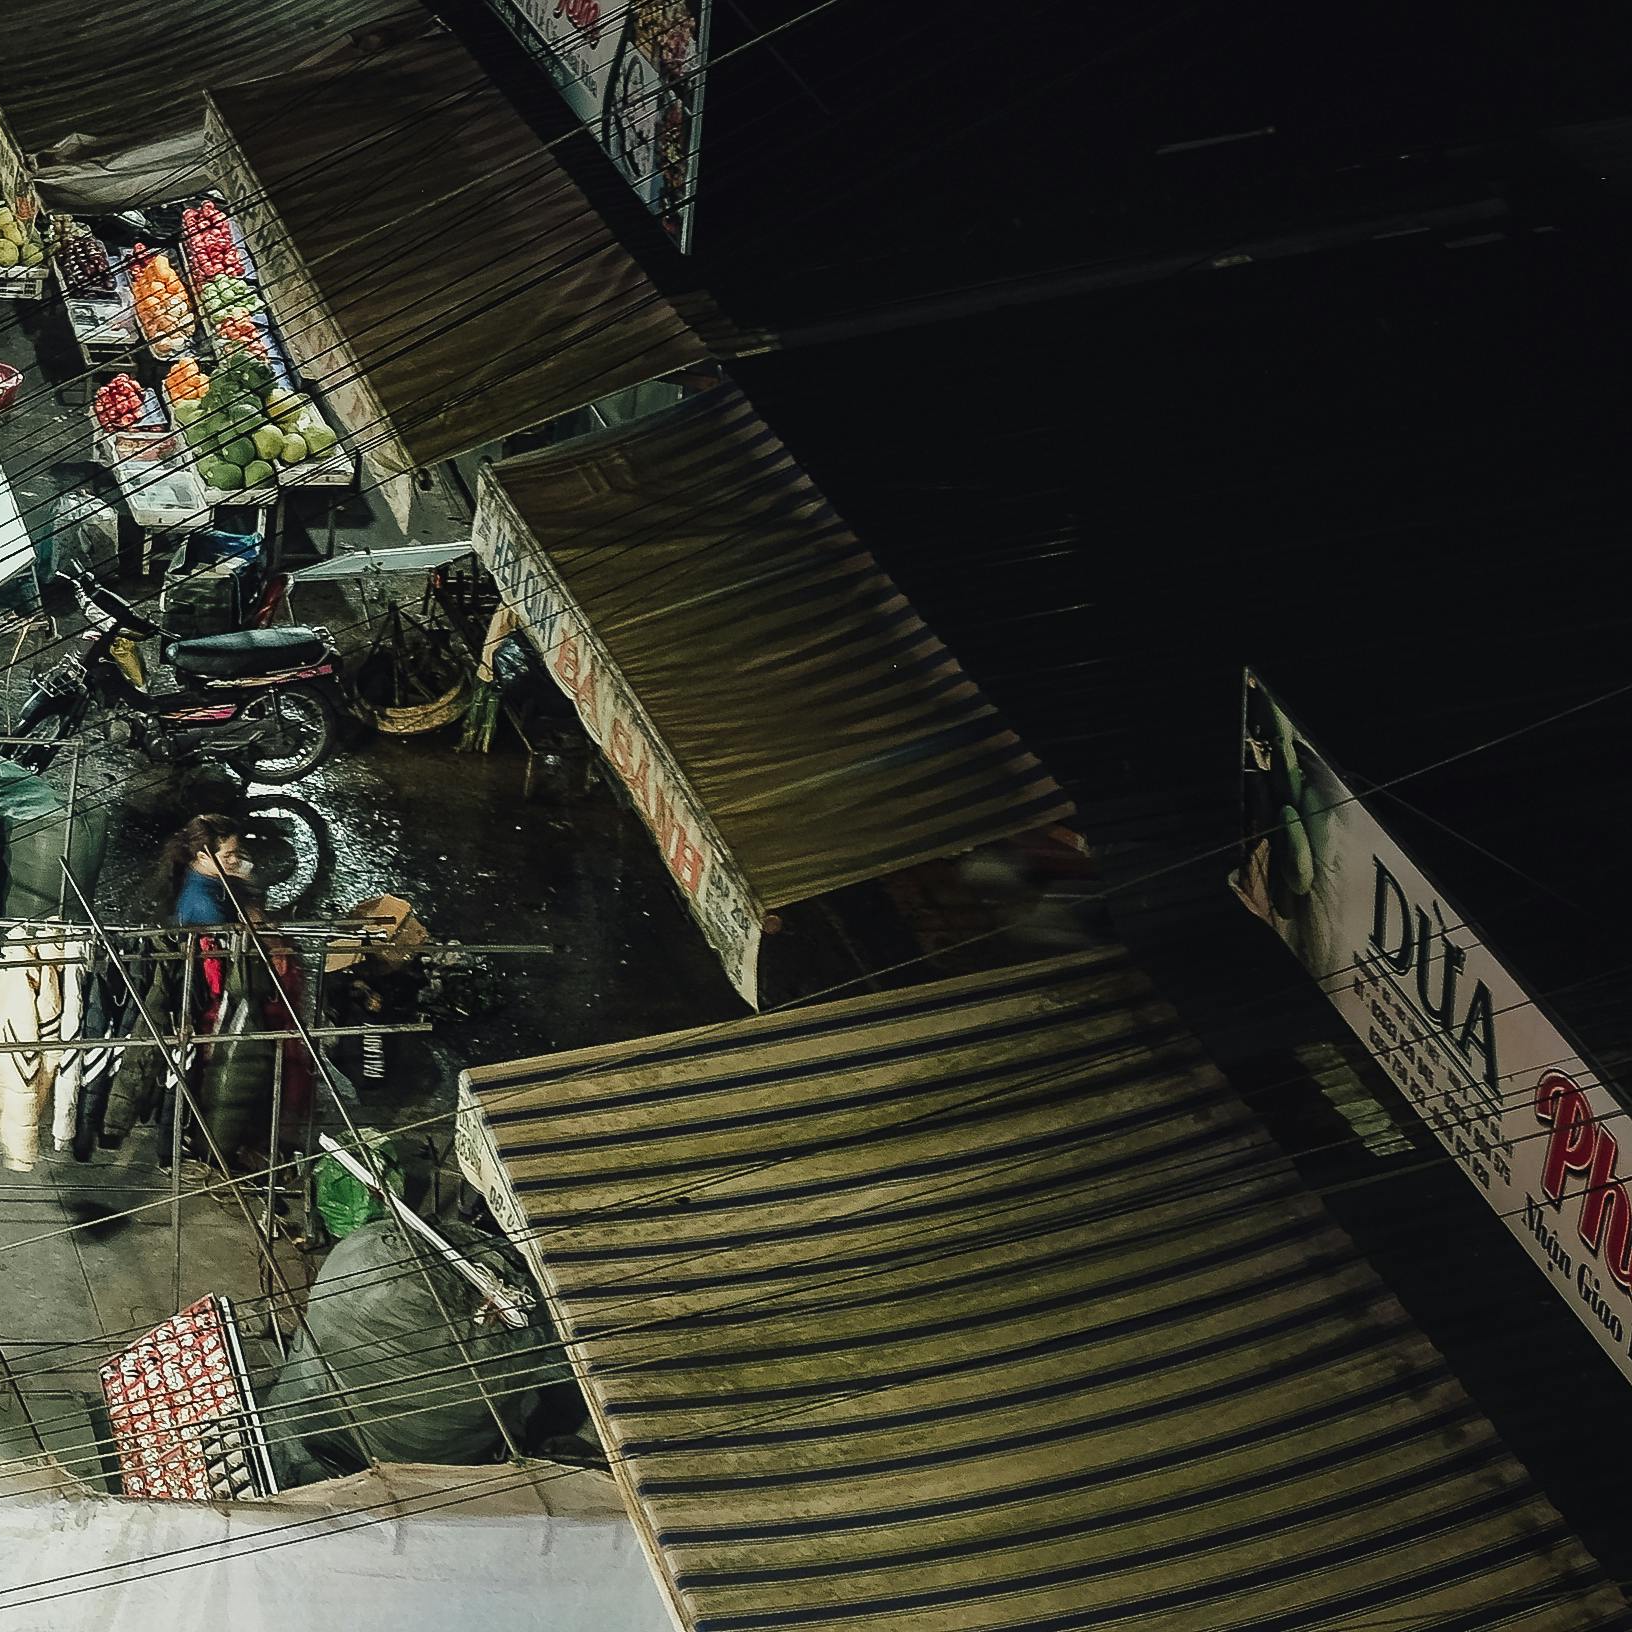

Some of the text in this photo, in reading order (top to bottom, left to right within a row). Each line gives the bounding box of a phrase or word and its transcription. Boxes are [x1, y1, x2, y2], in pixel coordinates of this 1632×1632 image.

[1369, 855, 1502, 1099] DỪA
[1520, 1191, 1624, 1344] Nhận Giao
